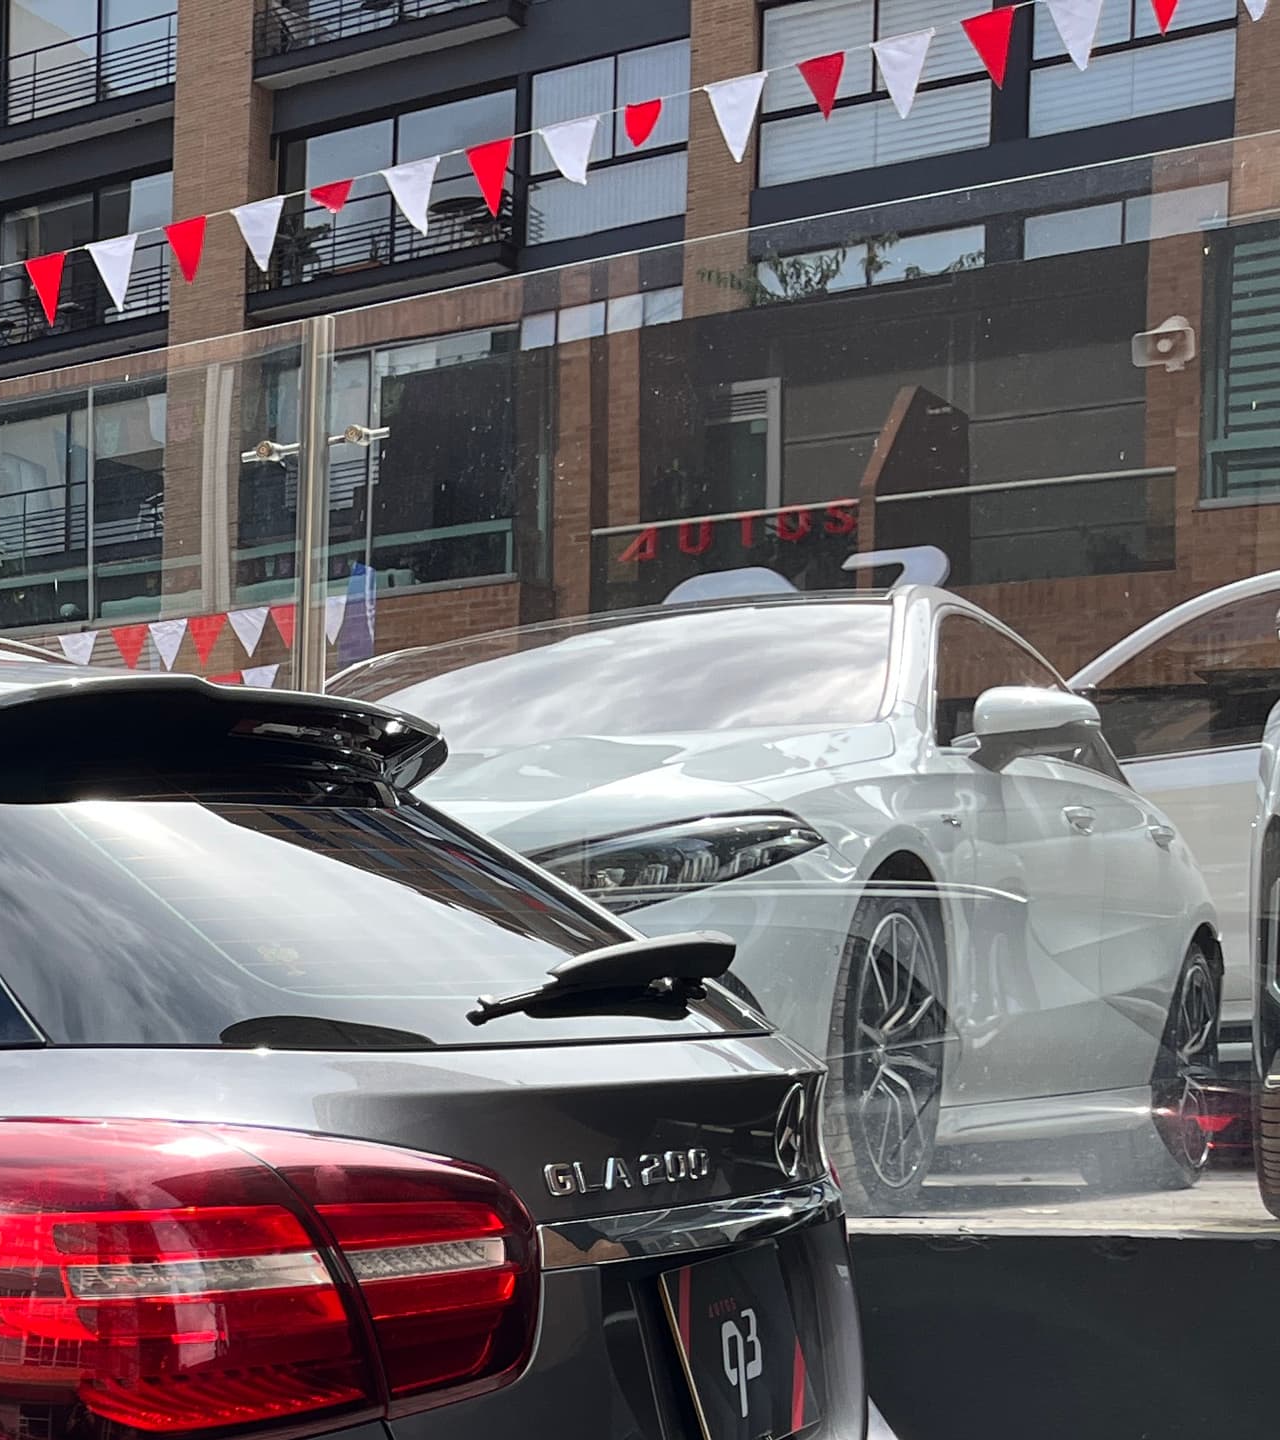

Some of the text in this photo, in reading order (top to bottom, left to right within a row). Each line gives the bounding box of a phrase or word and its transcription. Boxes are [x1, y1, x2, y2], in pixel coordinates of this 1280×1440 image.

[617, 497, 859, 563] AUTOS
[543, 1148, 711, 1197] GLA 200
[721, 1308, 762, 1418] 93
